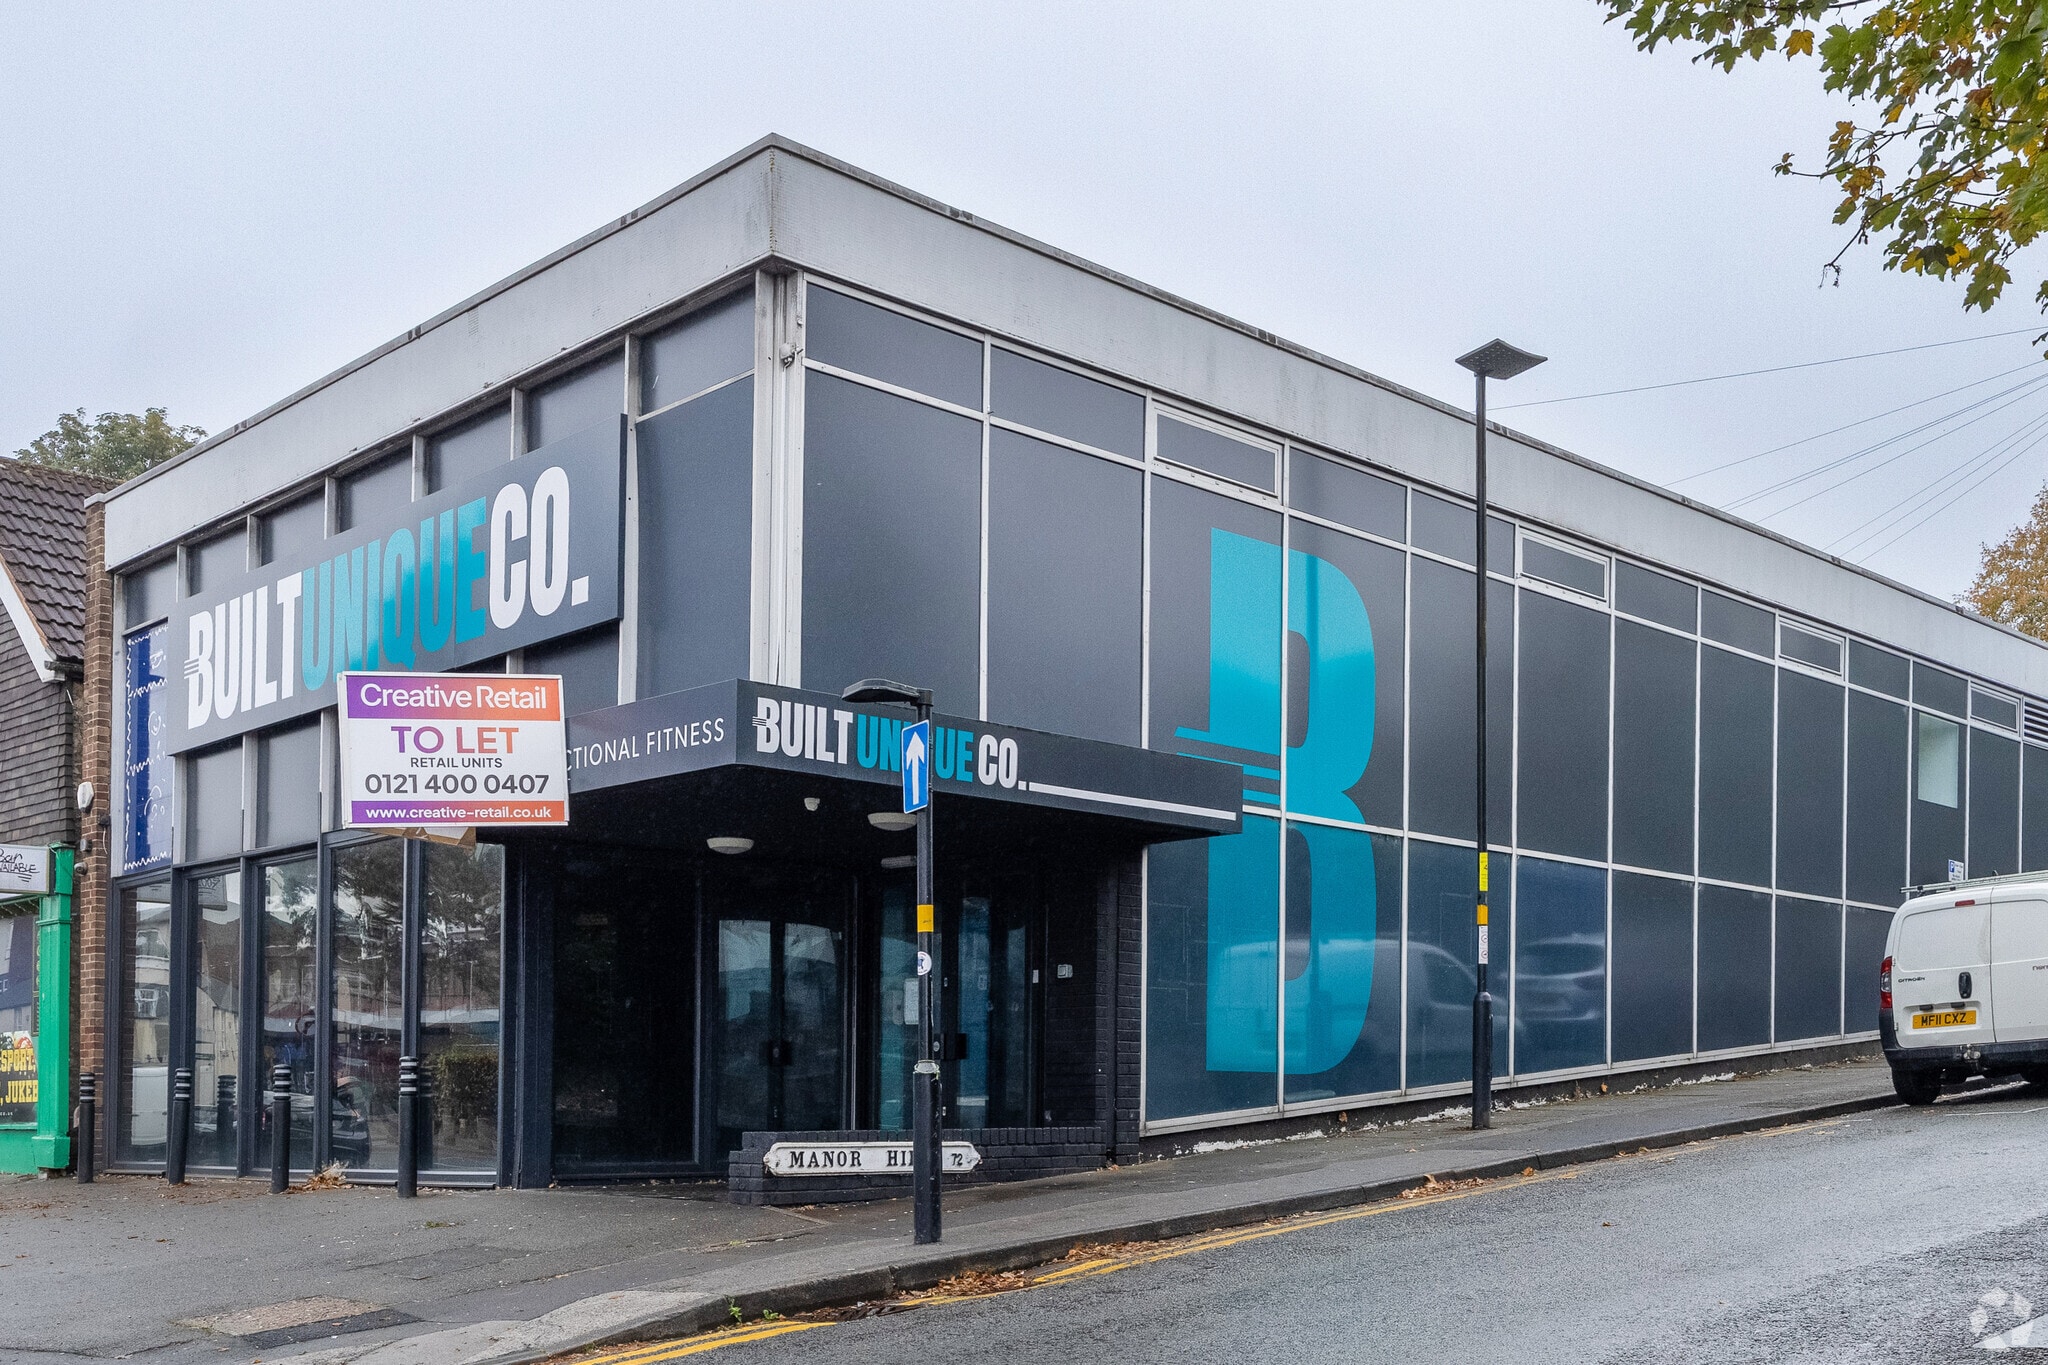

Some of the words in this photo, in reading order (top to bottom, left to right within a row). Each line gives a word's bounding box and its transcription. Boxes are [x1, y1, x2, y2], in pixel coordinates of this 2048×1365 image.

[360, 683, 472, 708] Creative
[476, 685, 547, 709] Retail
[391, 726, 444, 754] TO
[456, 726, 519, 754] LET
[646, 717, 725, 755] FITNESS
[857, 713, 974, 783] UNUE
[410, 757, 459, 768] RETAIL
[461, 757, 503, 768] UNITS
[365, 774, 418, 794] 0121
[424, 774, 477, 794] 400
[483, 774, 549, 794] 0407
[366, 806, 551, 819] www.creative-retail.co.uk
[790, 1150, 862, 1168] MANOR
[886, 1150, 914, 1167] HI
[951, 1153, 963, 1167] 72
